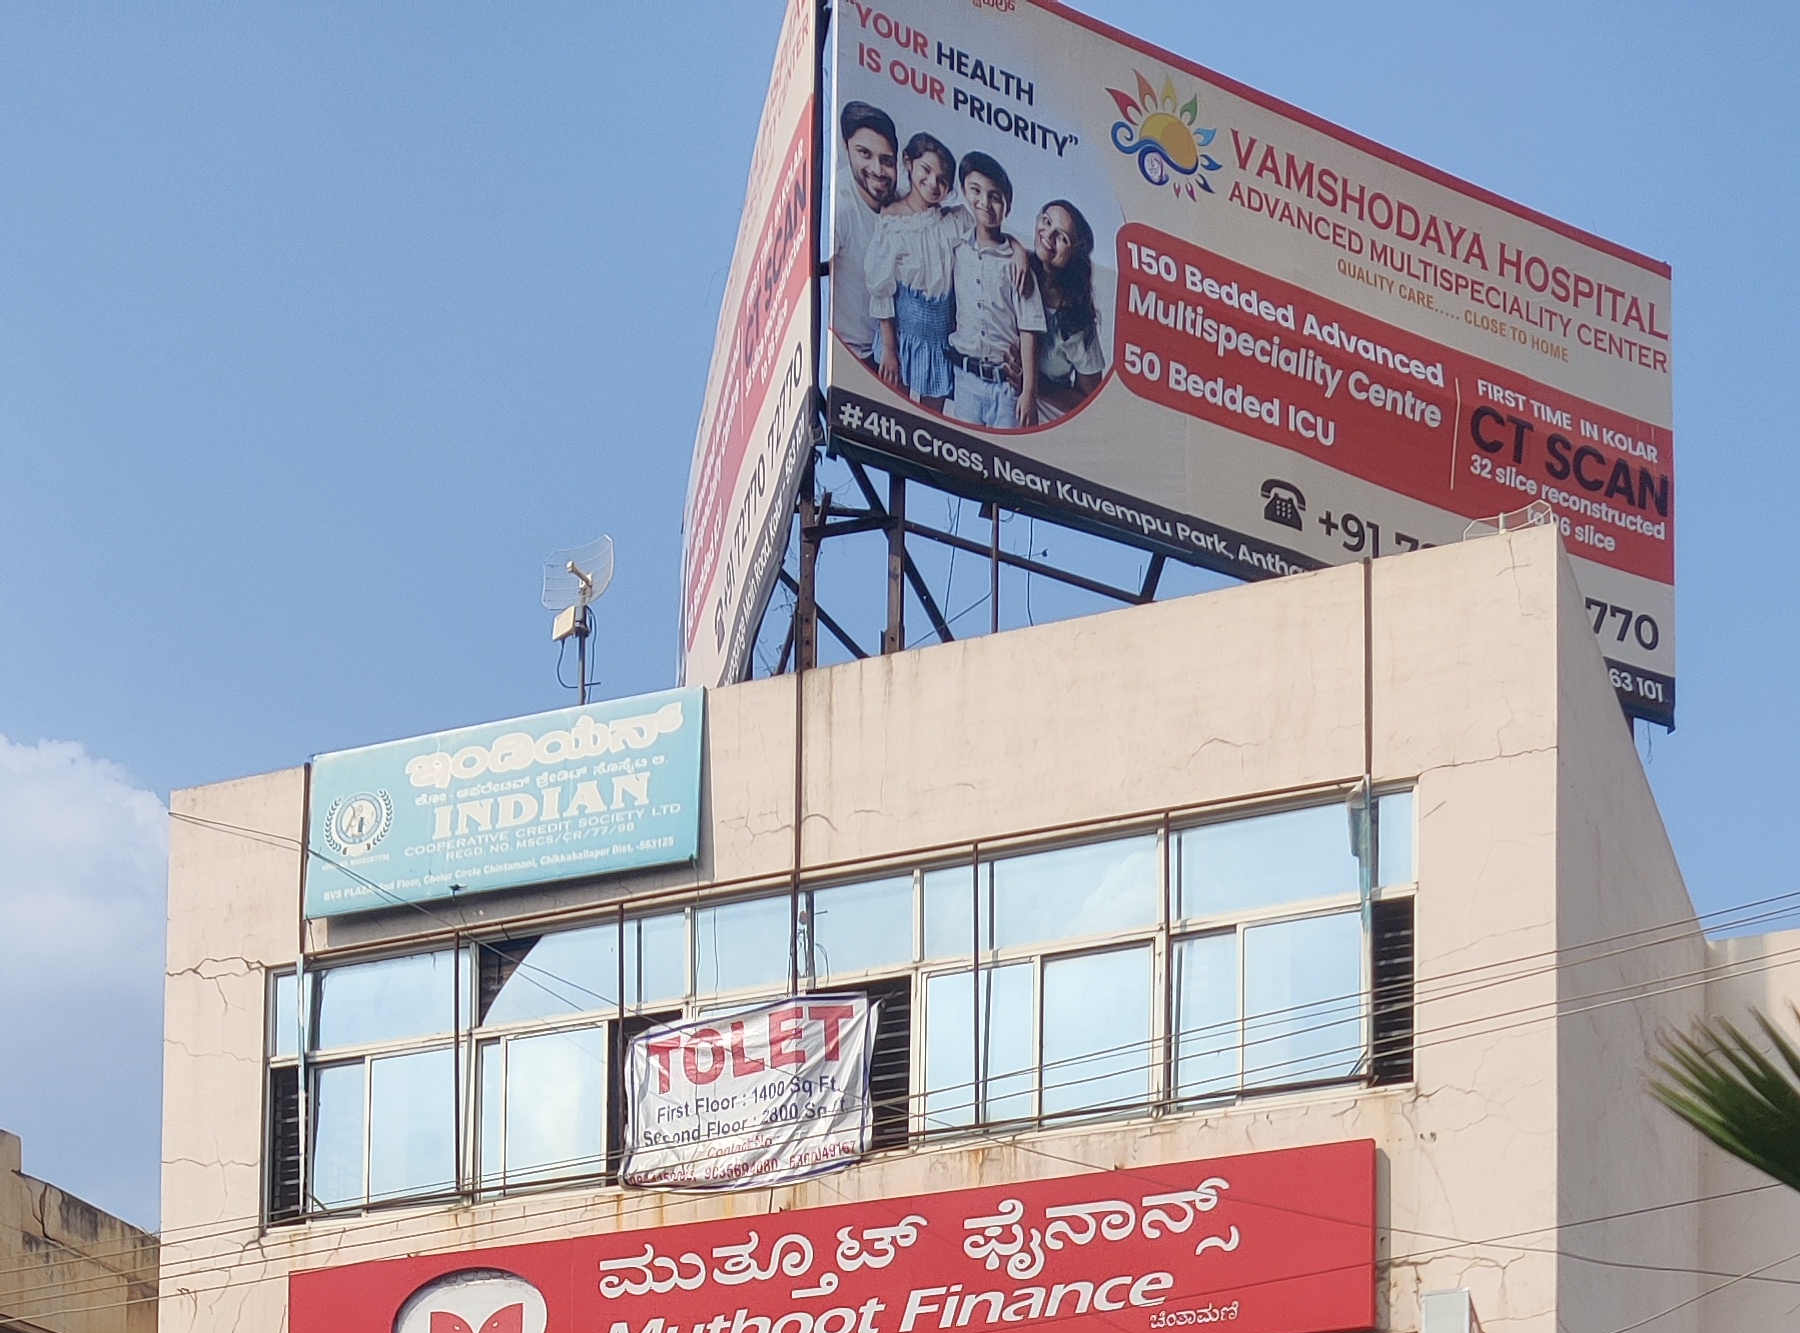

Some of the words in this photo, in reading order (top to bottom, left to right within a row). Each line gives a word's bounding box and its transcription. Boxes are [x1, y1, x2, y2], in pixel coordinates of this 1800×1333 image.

[857, 42, 882, 74] IS
[889, 58, 946, 105] OUR
[936, 41, 1034, 106] HEALTH
[779, 138, 803, 206] KOLAR
[746, 285, 762, 368] CT
[765, 159, 807, 312] SCAN
[1229, 127, 1489, 272] VAMSHODAYA
[1497, 242, 1670, 341] HOSPITAL
[764, 216, 806, 342] reconstructed
[1126, 242, 1178, 284] 150
[1184, 261, 1296, 331] Bedded
[1302, 312, 1445, 389] Advanced
[1227, 180, 1364, 256] ADVANCED
[1369, 238, 1572, 338] MULTISPECIALITY
[1577, 323, 1669, 374] CENTER
[1336, 258, 1395, 296] QUALITY
[1463, 310, 1508, 341] CLOSE
[1509, 324, 1529, 347] TO
[1531, 334, 1570, 364] HOME
[1123, 343, 1161, 382] 50
[1167, 360, 1280, 433] Bedded
[1287, 404, 1336, 447] ICU
[1127, 283, 1342, 398] Multispeciality
[1347, 369, 1443, 429] Centre
[734, 454, 766, 567] 72770
[768, 341, 803, 467] 72770
[1470, 406, 1534, 464] CT
[1546, 432, 1669, 518] SCAN
[1477, 379, 1527, 416] FIRST
[1530, 398, 1573, 432] TIME
[1580, 418, 1599, 440] IN
[1602, 427, 1659, 464] KOLAR
[838, 401, 906, 449] #4th
[912, 428, 989, 479] Cross,
[993, 456, 1051, 494] Near
[1057, 481, 1173, 540] Kuvempu
[1177, 521, 1233, 560] Park,
[1237, 543, 1312, 576] Antha
[1469, 453, 1493, 480] 32
[1494, 464, 1538, 501] slice
[1541, 480, 1666, 541] reconstructed
[1318, 511, 1381, 558] +91
[1575, 524, 1616, 552] slice
[744, 578, 757, 623] Main
[1585, 596, 1660, 652] 770
[1608, 665, 1634, 693] 63
[1637, 676, 1665, 704] 101
[404, 831, 509, 857] COOPERATIVE
[515, 820, 572, 838] CREDIT
[579, 809, 645, 827] SOCIETY
[652, 803, 681, 816] LTD
[432, 771, 651, 839] INDIAN
[446, 846, 487, 861] REGD.
[647, 1005, 854, 1095] TOLET
[657, 1102, 690, 1124] First
[695, 1094, 738, 1116] Floor
[752, 1080, 785, 1102] 1400
[789, 1075, 813, 1097] Sq
[707, 1118, 749, 1139] Floor
[598, 1215, 928, 1299] ಮುತ್ತೂಟ್
[963, 1177, 1242, 1280] ಫೈನಾನ್ಸ್
[899, 1270, 1174, 1333] Finance
